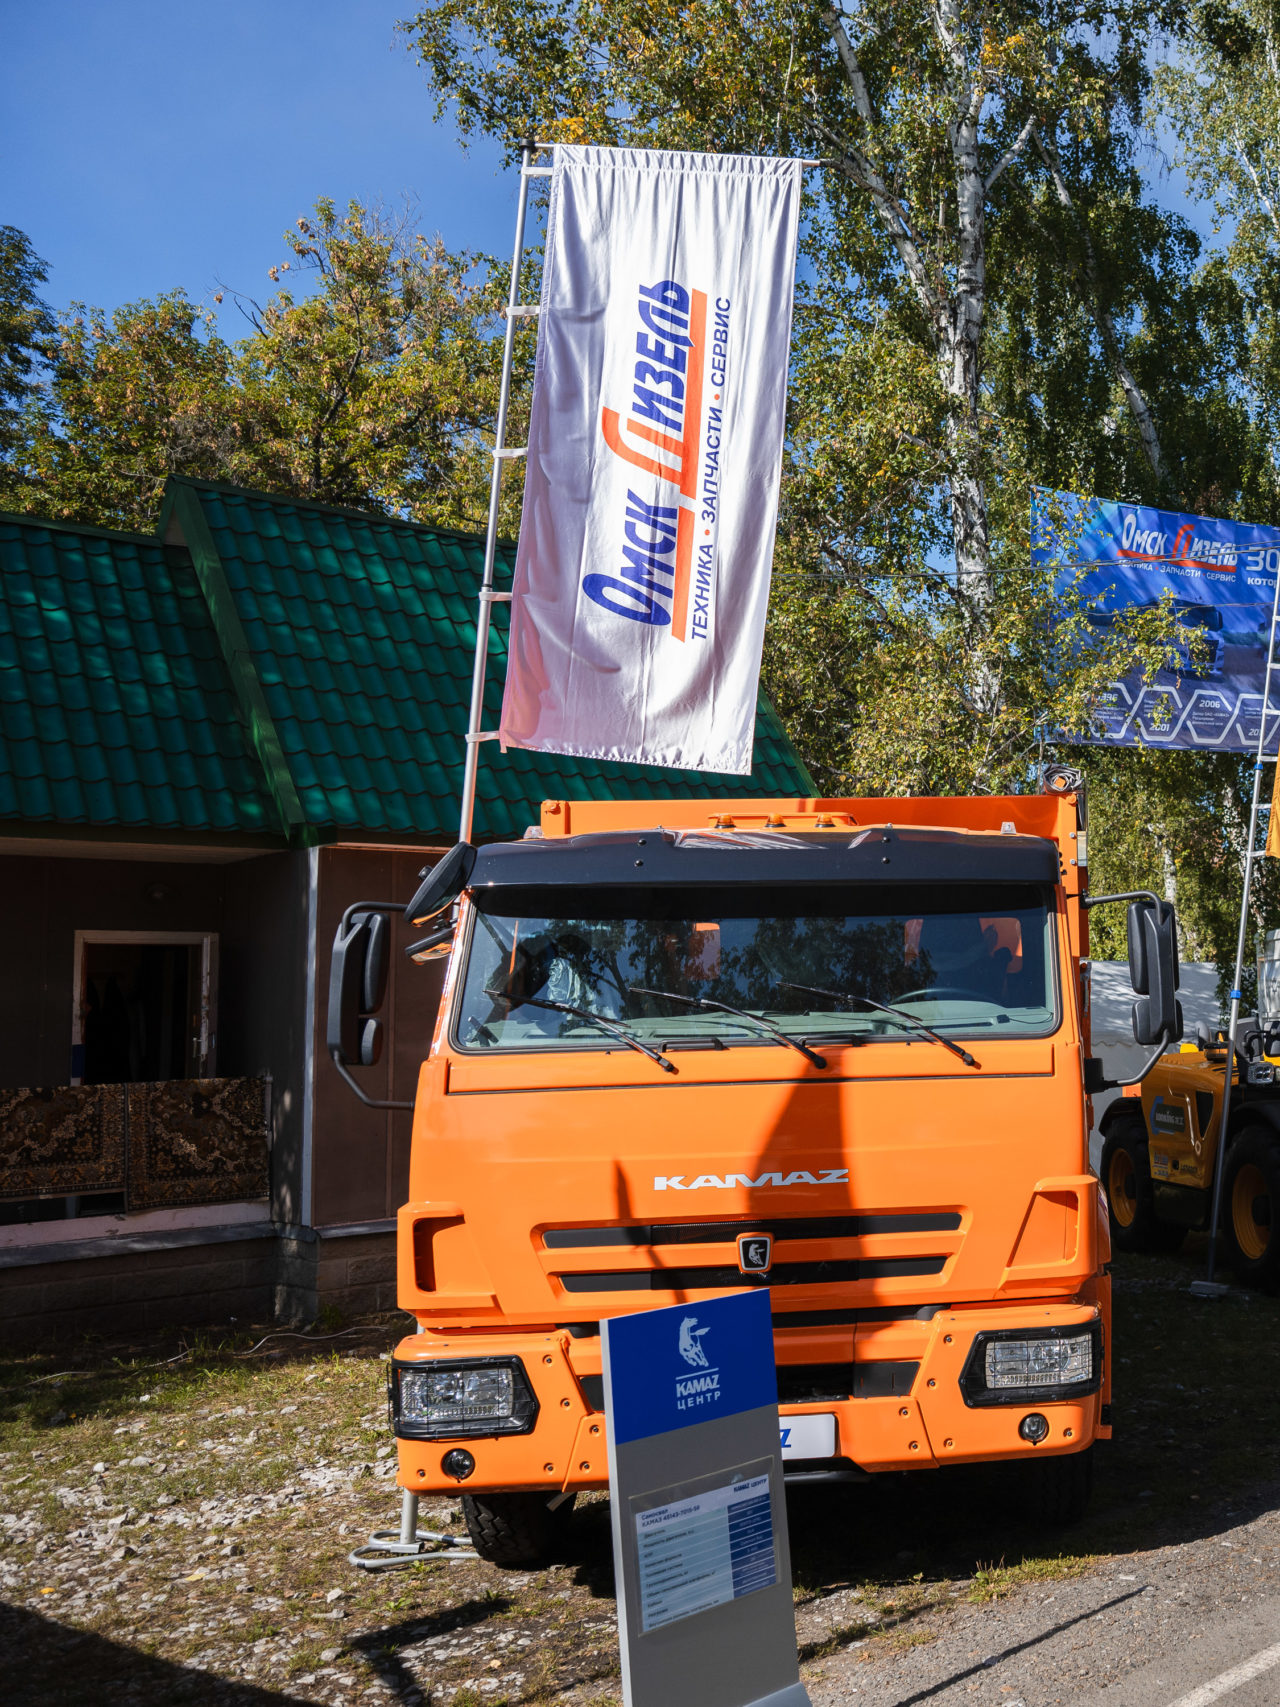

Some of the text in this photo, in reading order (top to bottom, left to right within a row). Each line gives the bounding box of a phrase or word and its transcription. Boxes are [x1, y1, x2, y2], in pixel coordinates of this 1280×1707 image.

[692, 297, 731, 641] ТЕХНИКА ЗАПЧАСТИ СЕРВИС
[583, 488, 679, 626] ОМСК
[1160, 565, 1201, 578] ЗАПЧАСТИ
[1206, 572, 1236, 583] СЕРВИС
[1199, 700, 1220, 708] 2006
[1149, 723, 1170, 732] 2001
[654, 1169, 849, 1190] KAMAZ
[676, 1374, 720, 1398] KAMAZ
[677, 1391, 721, 1410] ЦЕНТР
